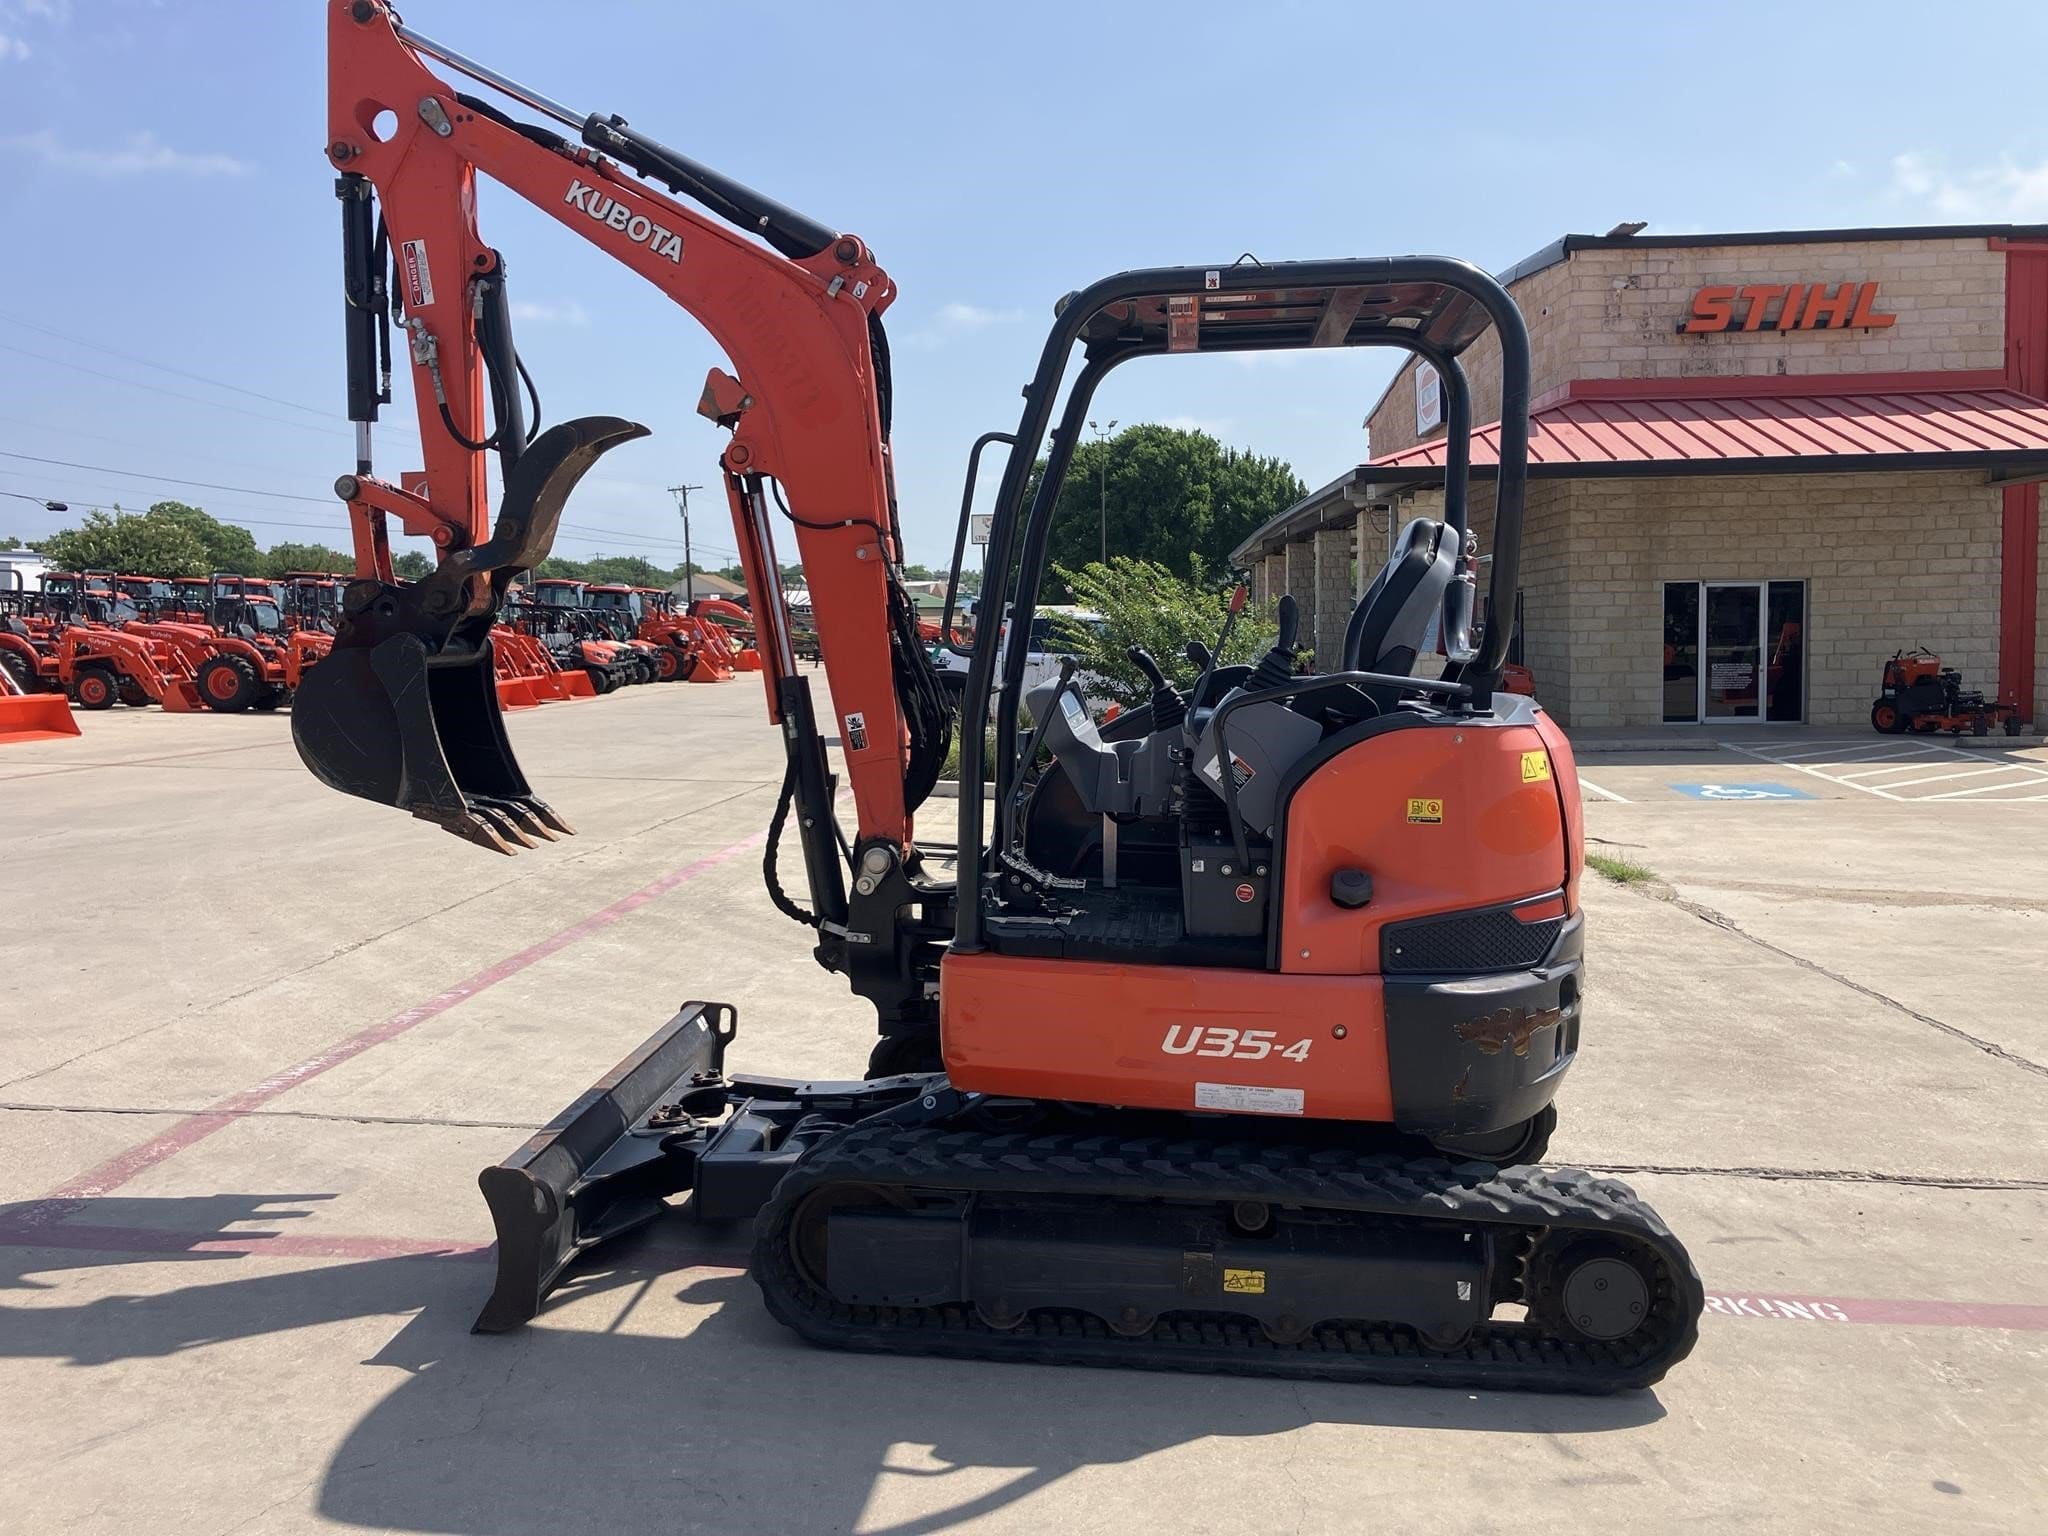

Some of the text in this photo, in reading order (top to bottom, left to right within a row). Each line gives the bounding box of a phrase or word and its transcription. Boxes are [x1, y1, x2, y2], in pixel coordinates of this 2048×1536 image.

[563, 178, 683, 265] KUBOTA
[408, 256, 421, 292] DANGER
[1684, 281, 1897, 333] STIHL
[1161, 1024, 1313, 1063] U35-4
